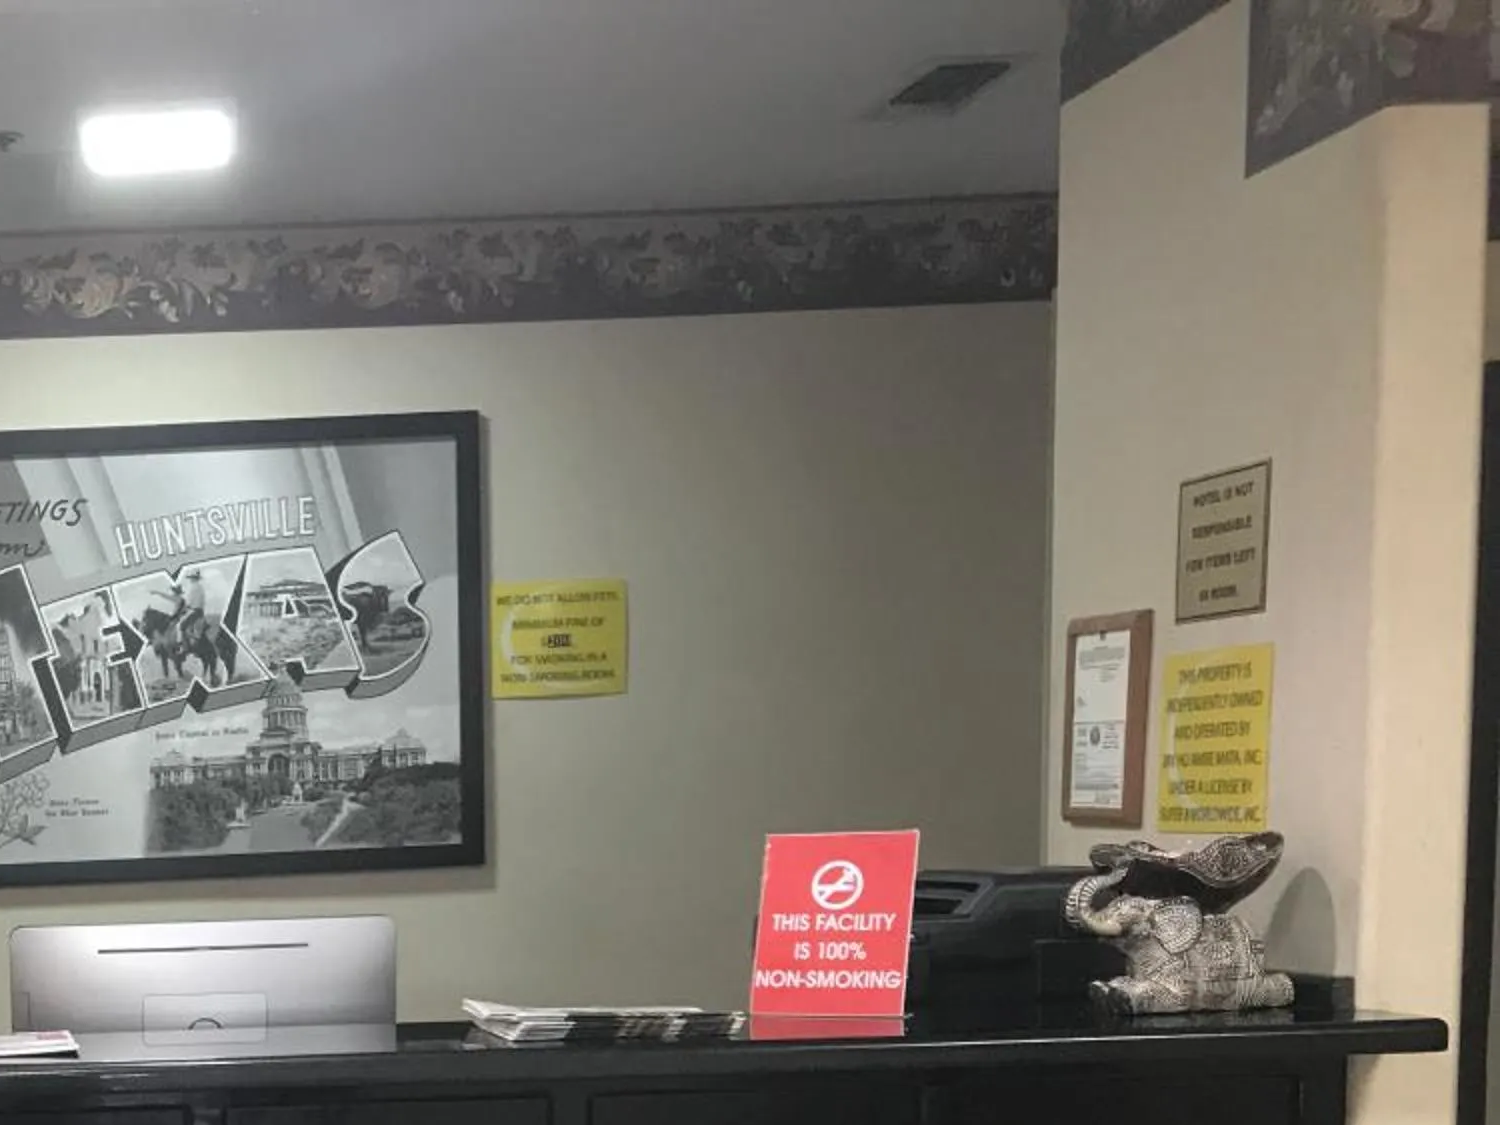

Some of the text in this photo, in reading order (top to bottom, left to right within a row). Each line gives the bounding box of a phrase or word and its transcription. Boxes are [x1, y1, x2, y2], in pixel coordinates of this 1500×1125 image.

[114, 495, 316, 568] HUNTSVILLE
[772, 913, 897, 931] THIS FACILITY
[793, 941, 867, 961] IS 100%
[755, 969, 902, 989] NON-SMOKING
